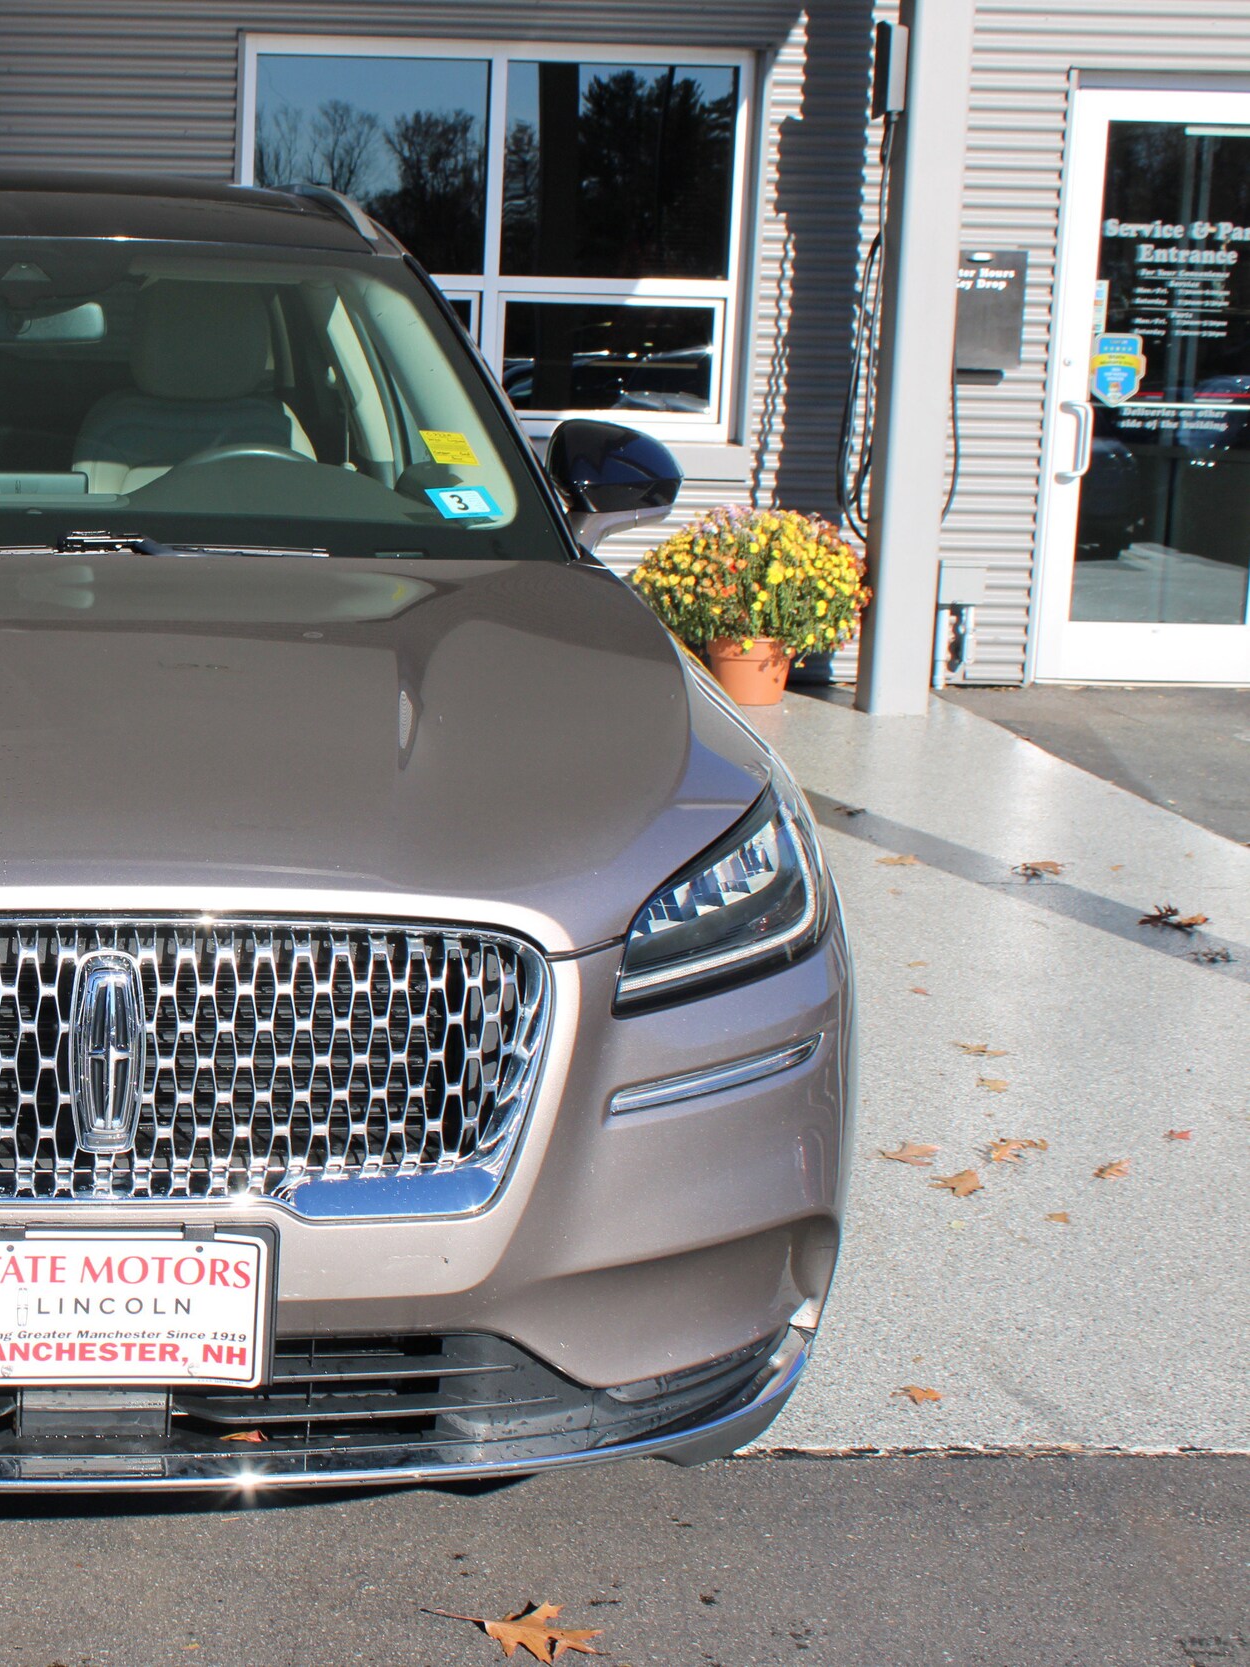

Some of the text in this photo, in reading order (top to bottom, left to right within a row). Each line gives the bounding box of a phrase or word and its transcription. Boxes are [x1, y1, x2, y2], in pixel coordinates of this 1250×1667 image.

[1103, 218, 1185, 239] Service
[1188, 220, 1211, 240] &
[1135, 243, 1238, 265] Entrance
[958, 267, 1016, 279] ter Hours
[976, 279, 1007, 291] Drop
[1121, 407, 1177, 417] Deliveries
[1196, 409, 1227, 419] other
[1160, 420, 1179, 430] the
[450, 494, 469, 511] 3
[79, 1255, 251, 1289] MOTORS
[37, 1297, 192, 1315] LINCOLN
[17, 1329, 71, 1340] Greater
[77, 1329, 161, 1340] Manchester
[166, 1330, 206, 1341] Since
[211, 1330, 248, 1343] 1919
[202, 1344, 246, 1366] NH
